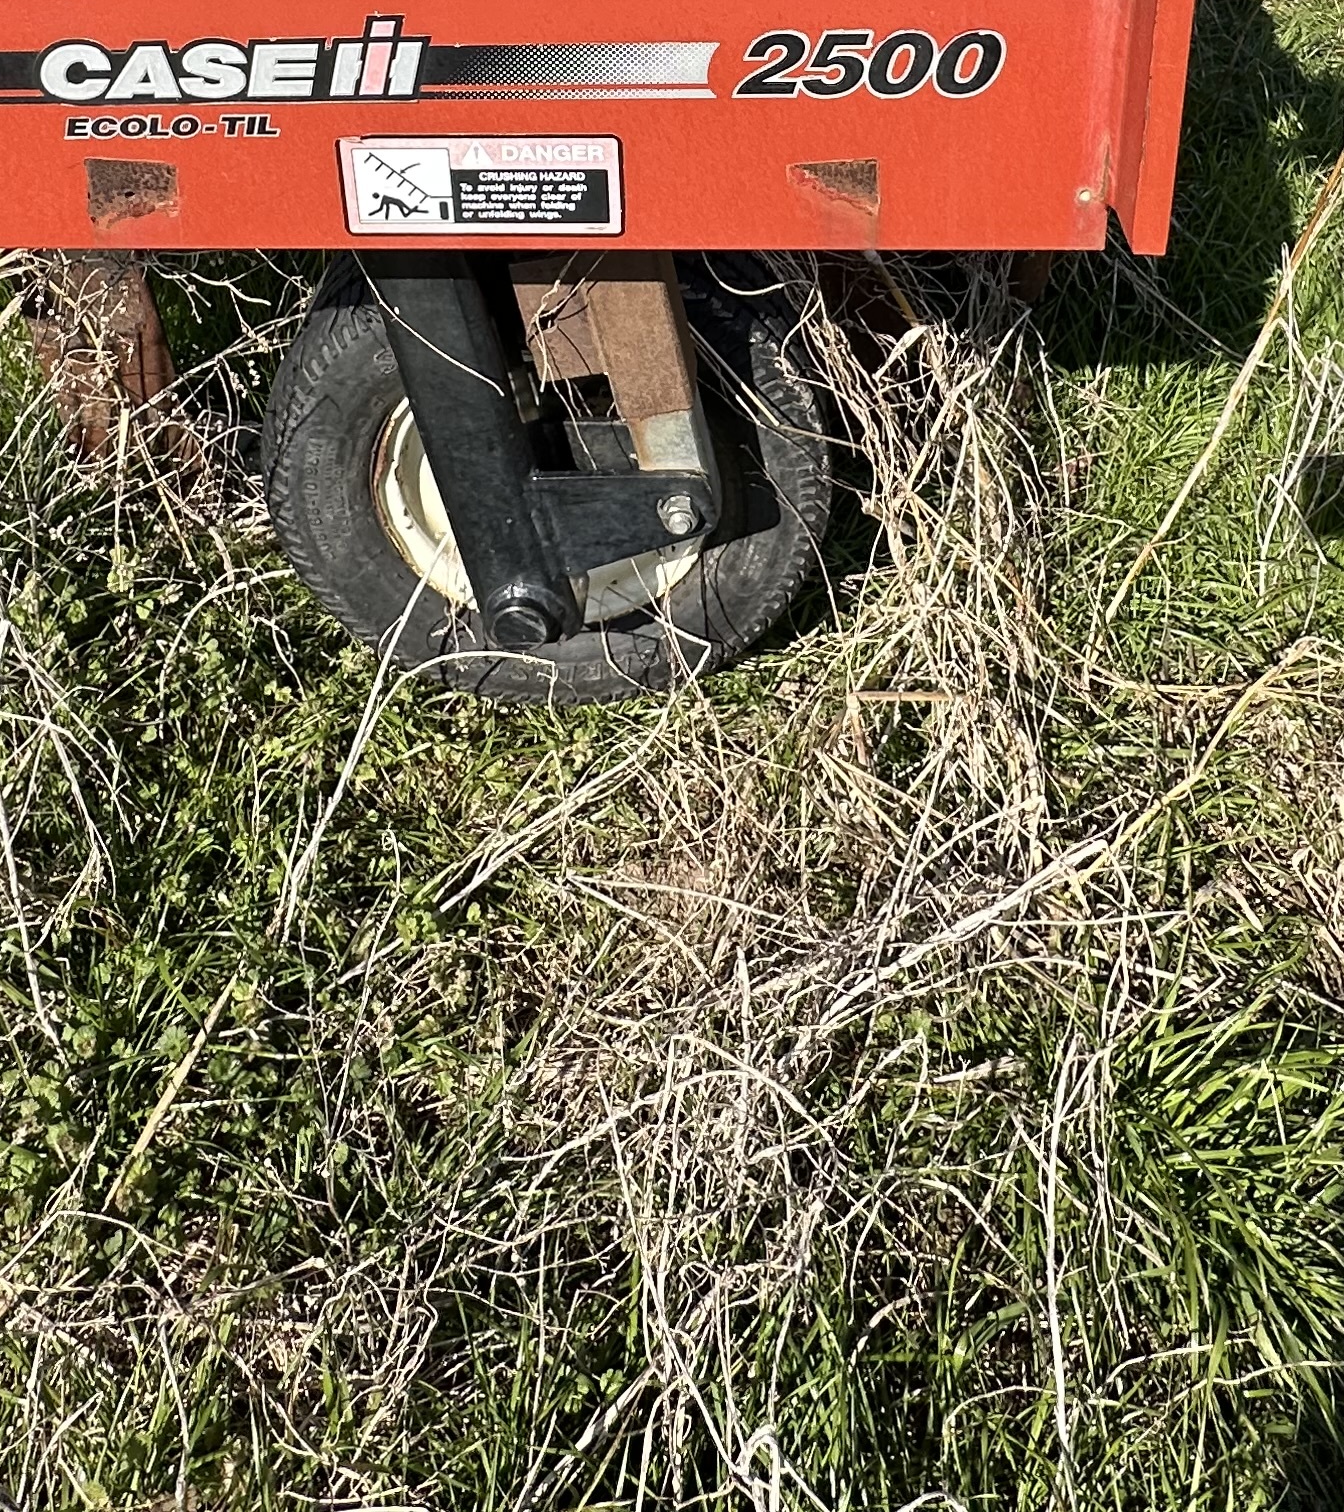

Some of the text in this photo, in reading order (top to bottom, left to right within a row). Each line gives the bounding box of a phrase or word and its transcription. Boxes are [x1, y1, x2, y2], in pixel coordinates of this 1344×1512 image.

[39, 42, 320, 101] CASE
[734, 31, 1004, 97] 2500
[501, 144, 605, 162] DANGER
[478, 172, 585, 181] CRUSHING HAZARD
[459, 183, 473, 191] To
[477, 183, 505, 191] avoid
[509, 183, 538, 193] injury
[557, 183, 588, 191] death
[460, 192, 582, 202] keep everyone clear of
[461, 201, 576, 211] machine when folding
[478, 209, 525, 220] unfolding
[529, 210, 562, 220] wings.
